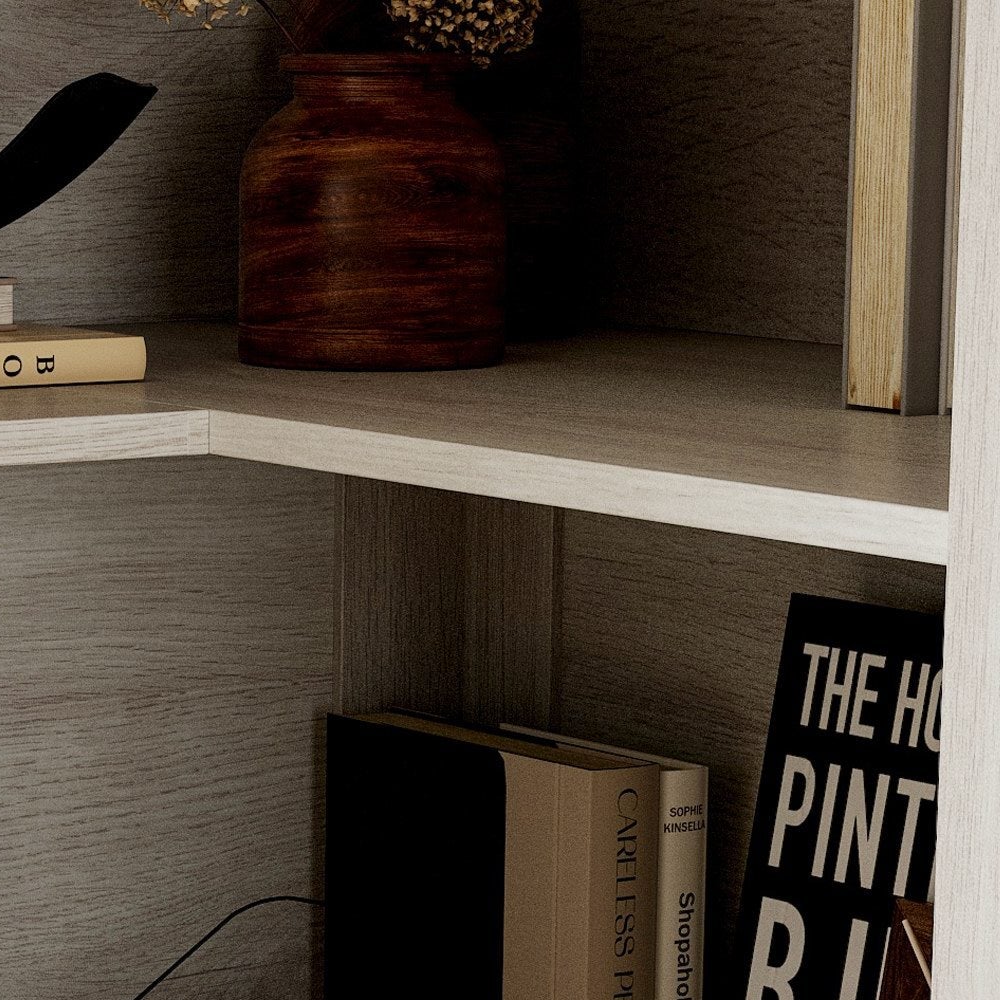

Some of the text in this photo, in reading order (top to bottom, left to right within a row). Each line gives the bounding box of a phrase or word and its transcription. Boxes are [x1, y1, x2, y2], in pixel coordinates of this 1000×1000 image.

[800, 642, 887, 740] THE
[663, 820, 706, 834] KINSELLA
[669, 804, 704, 818] SOPHIE
[768, 754, 937, 902] PINT
[614, 788, 639, 958] CARELESS
